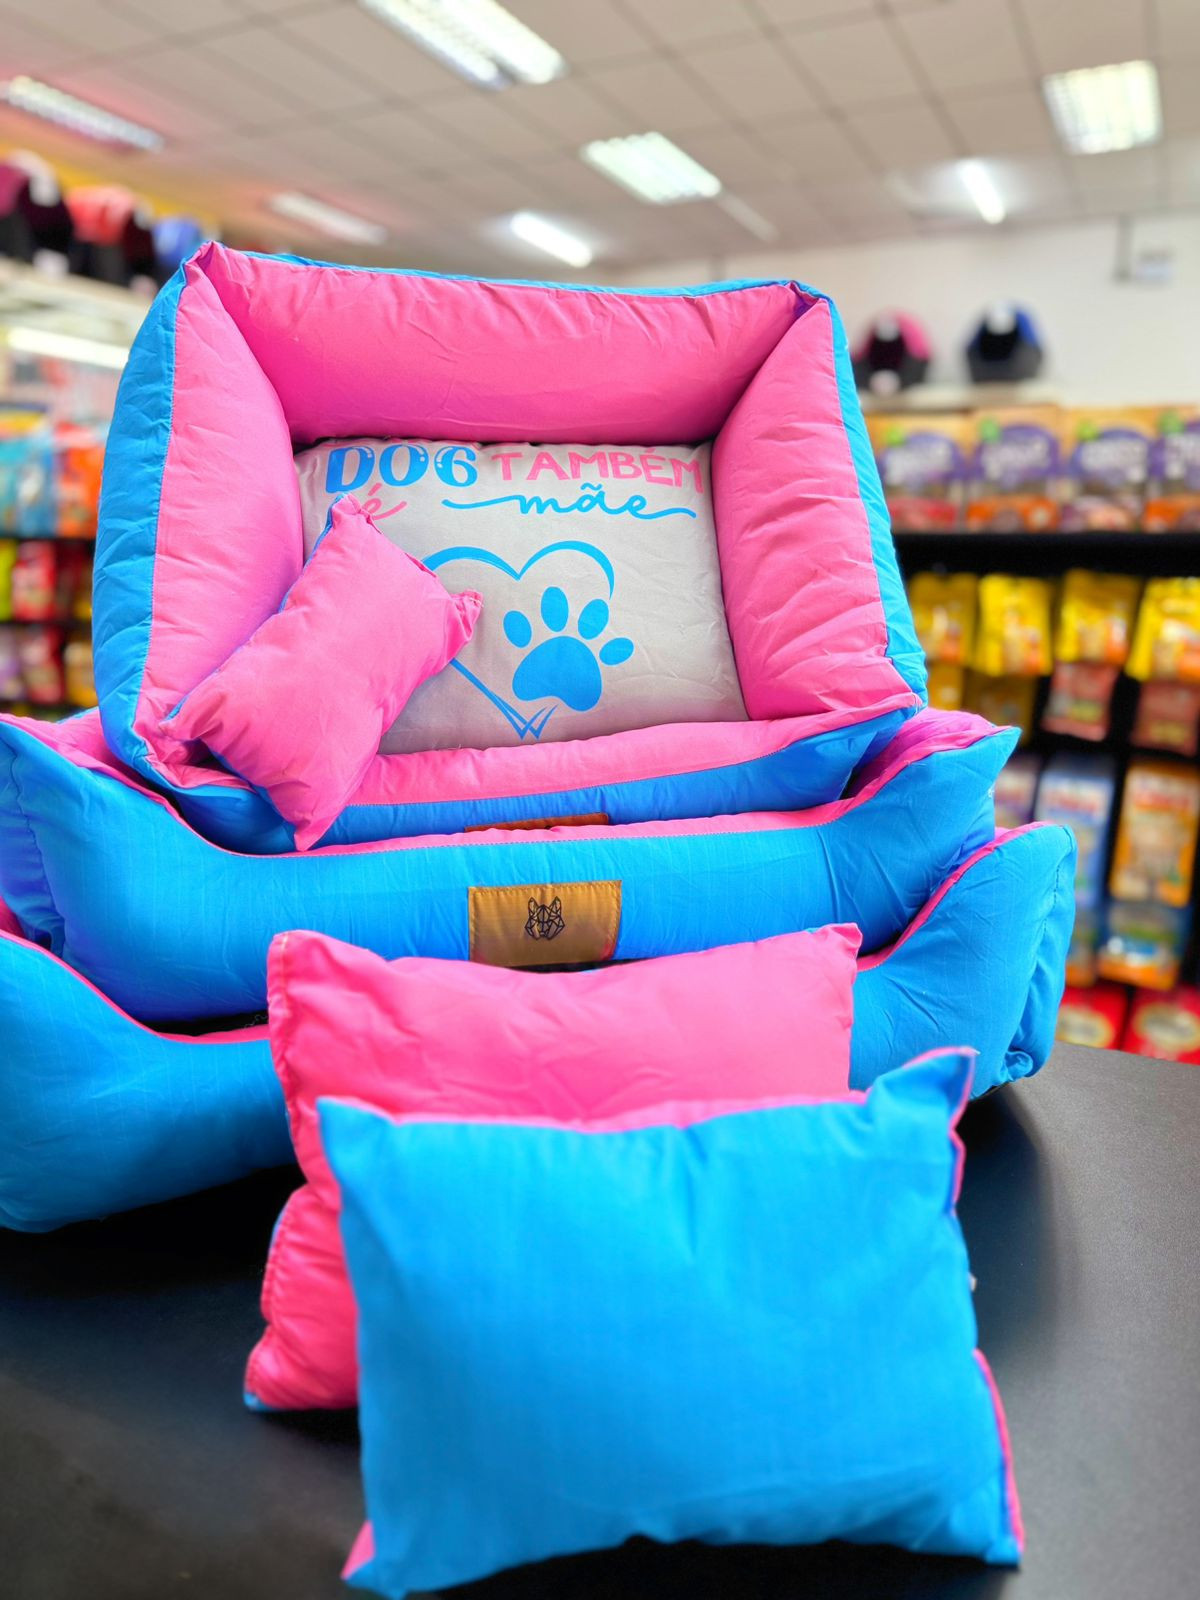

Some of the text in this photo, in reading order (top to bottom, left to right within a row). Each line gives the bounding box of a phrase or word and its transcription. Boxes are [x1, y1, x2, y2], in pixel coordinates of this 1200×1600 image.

[325, 444, 704, 494] DOG TAMBÉM
[362, 482, 697, 521] é mãe
